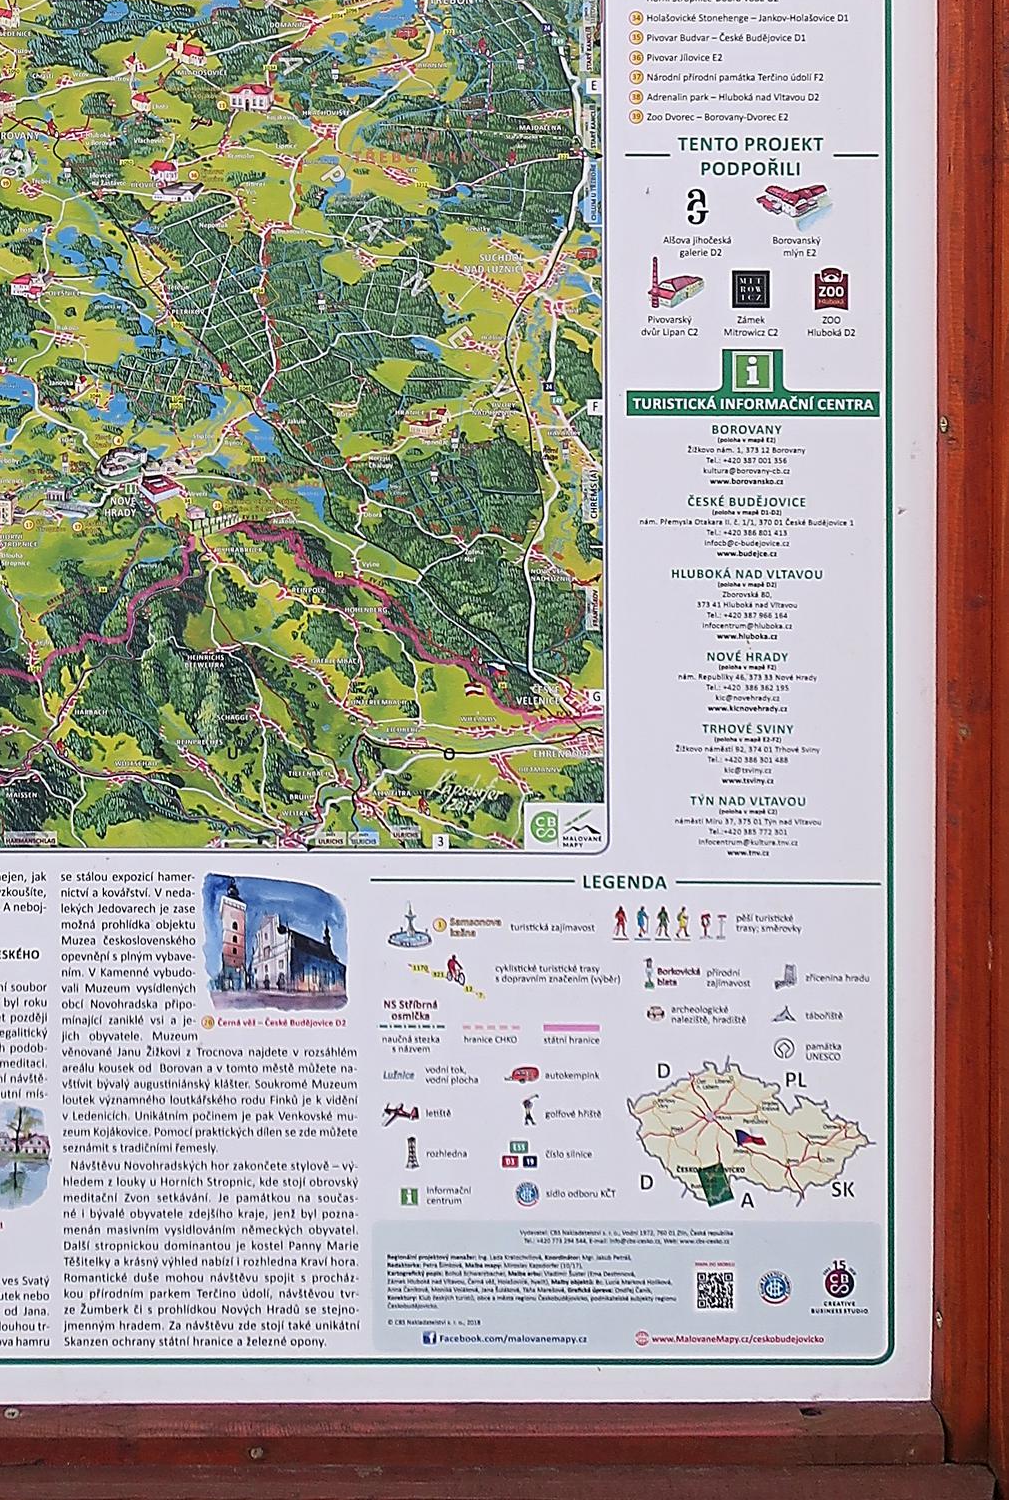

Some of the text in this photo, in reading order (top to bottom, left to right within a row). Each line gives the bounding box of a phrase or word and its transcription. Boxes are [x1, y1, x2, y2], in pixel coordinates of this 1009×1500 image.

[647, 53, 723, 62] Pivovar Jílovice E2
[677, 137, 824, 151] TENTO PROJEKT
[701, 158, 800, 176] PODPOŘILI
[773, 236, 821, 246] Borovanský
[783, 248, 817, 258] mlýn E2
[819, 286, 844, 297] ZOO
[737, 316, 765, 324] Zámek
[822, 316, 841, 324] ZOO
[724, 328, 778, 337] Mitrowicz C2
[807, 328, 855, 337] Hluboká D2
[632, 395, 874, 410] TURISTICKÁ INFORMAČNÍ CENTRA
[712, 424, 782, 435] BOROVANY
[687, 494, 806, 507] ČESKÉ BUDĚJOVICE
[717, 550, 777, 558] www.budejce.cz
[671, 567, 823, 580] HLUBOKÁ NAD VLTAVOU
[707, 650, 788, 662] NOVÉ HRADY
[702, 722, 793, 734] TRHOVÉ SVINY
[690, 794, 806, 806] TÝN NAD VLTAVOU
[583, 875, 667, 890] LEGENDA
[510, 923, 595, 933] turistická zajímavost
[545, 1071, 599, 1081] autokempink
[657, 1063, 671, 1079] D
[786, 1072, 807, 1088] PL
[545, 1110, 601, 1120] golfové hřiště
[426, 1149, 467, 1158] rozhledna
[641, 1174, 653, 1190] D
[829, 1180, 855, 1198] SK
[741, 1192, 755, 1208] A
[64, 1336, 327, 1348] Skanzen ochrany státní hranice a železné opony.
[439, 1334, 587, 1344] Facebook.com/malovanemapy.cz
[651, 1334, 825, 1344] www.MalovaneMapy.cz/ceskobudejovicko
